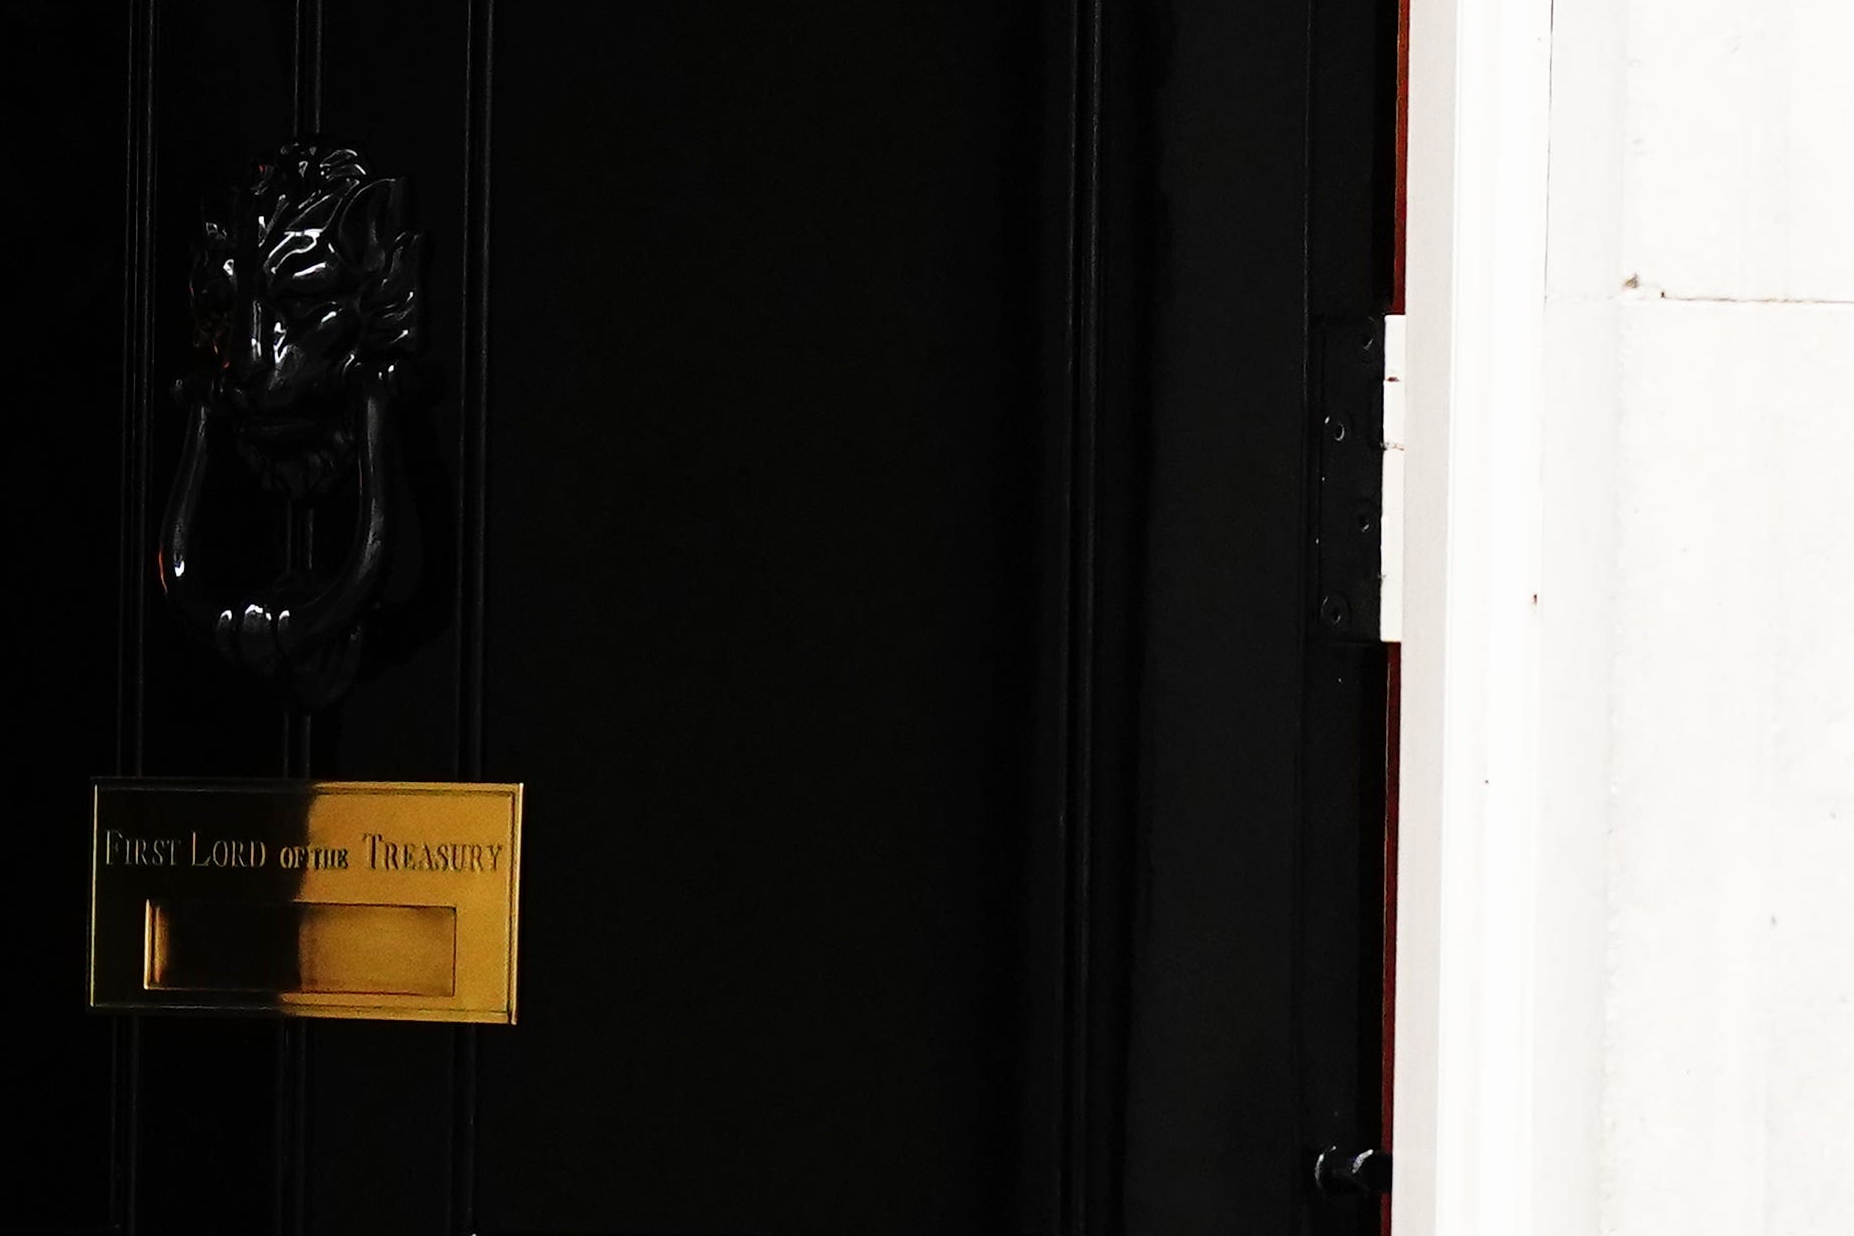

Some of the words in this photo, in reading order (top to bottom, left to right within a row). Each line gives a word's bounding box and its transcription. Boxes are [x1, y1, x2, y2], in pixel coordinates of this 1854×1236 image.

[105, 830, 180, 867] FIRST
[190, 831, 266, 868] LORD
[279, 847, 305, 869] OF
[306, 847, 348, 870] THE
[362, 833, 504, 873] TREASURY
